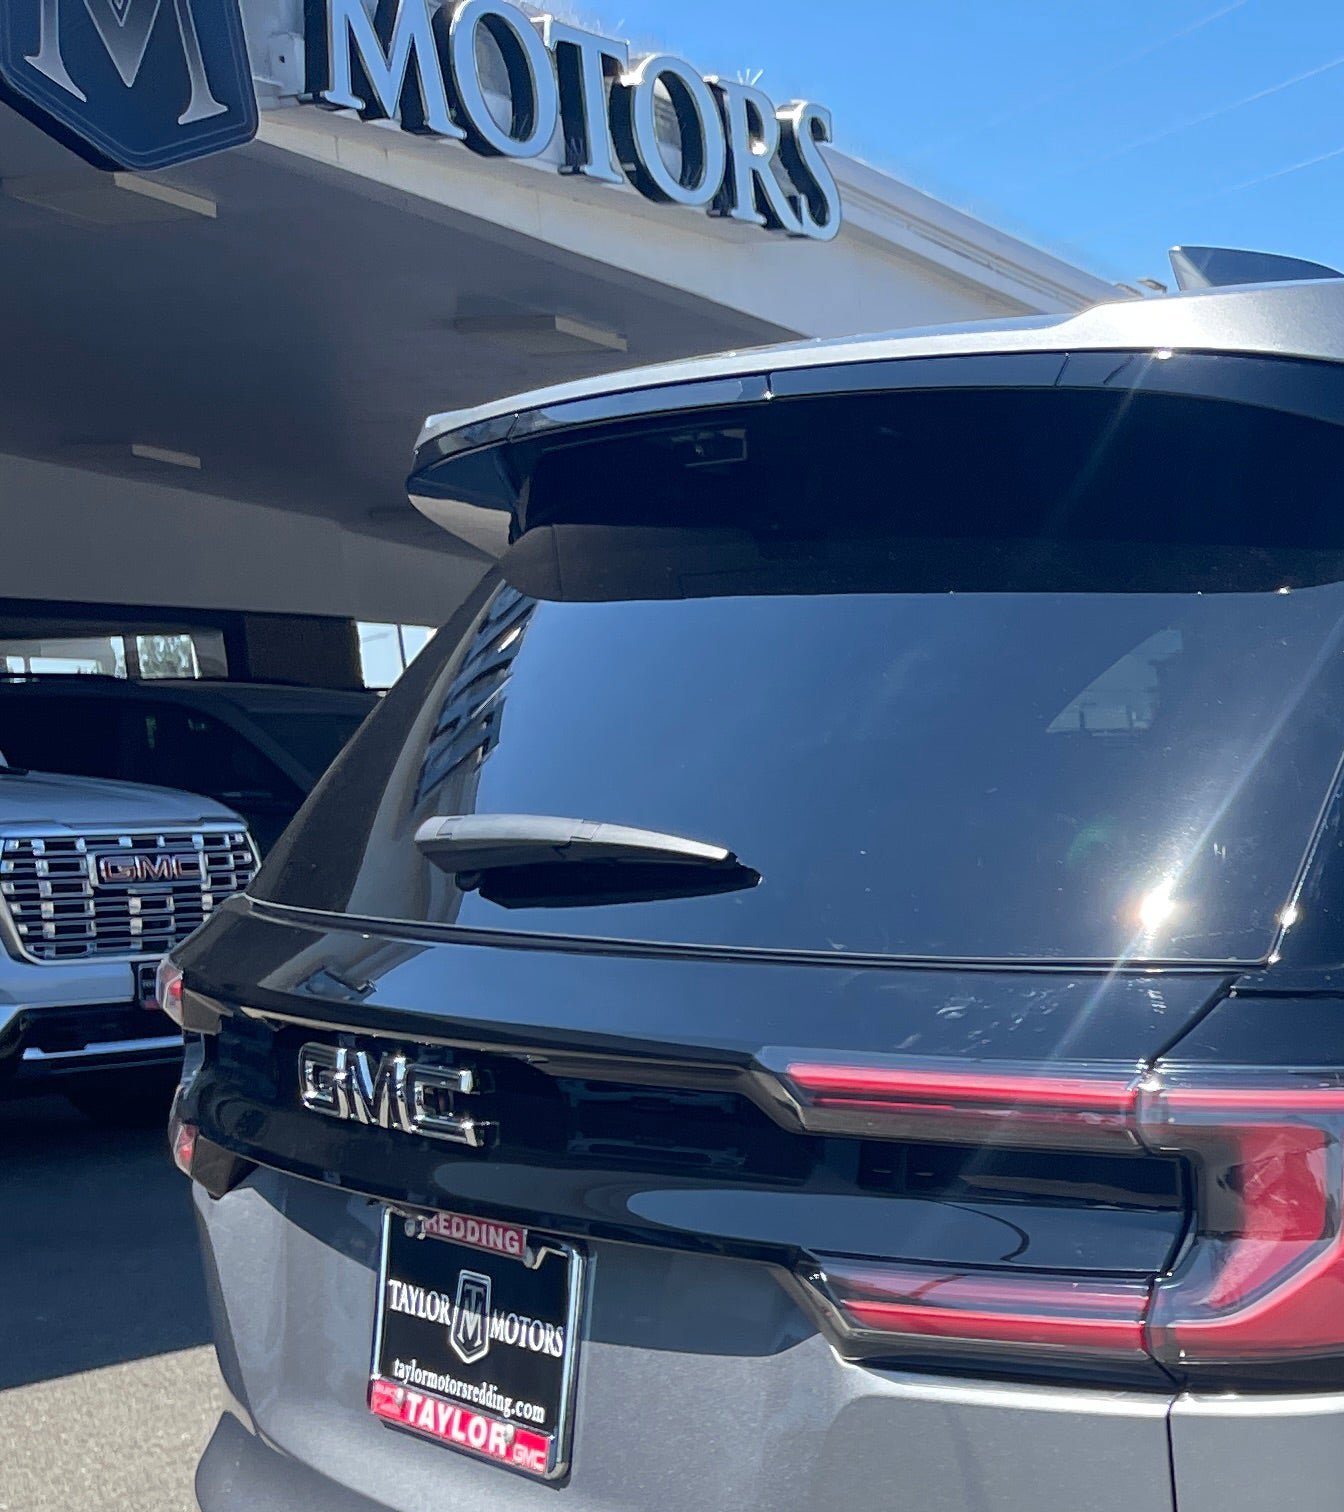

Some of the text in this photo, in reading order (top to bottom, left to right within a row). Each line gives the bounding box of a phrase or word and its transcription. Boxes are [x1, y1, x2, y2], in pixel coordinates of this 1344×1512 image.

[305, 0, 842, 242] MOTORS
[100, 855, 201, 883] GMC
[299, 1041, 485, 1147] GMC
[424, 1214, 520, 1252] REDDING
[388, 1278, 566, 1358] TAYLOR MOTORS
[393, 1356, 546, 1424] taylormotorsredding.com
[512, 1444, 546, 1471] GMC
